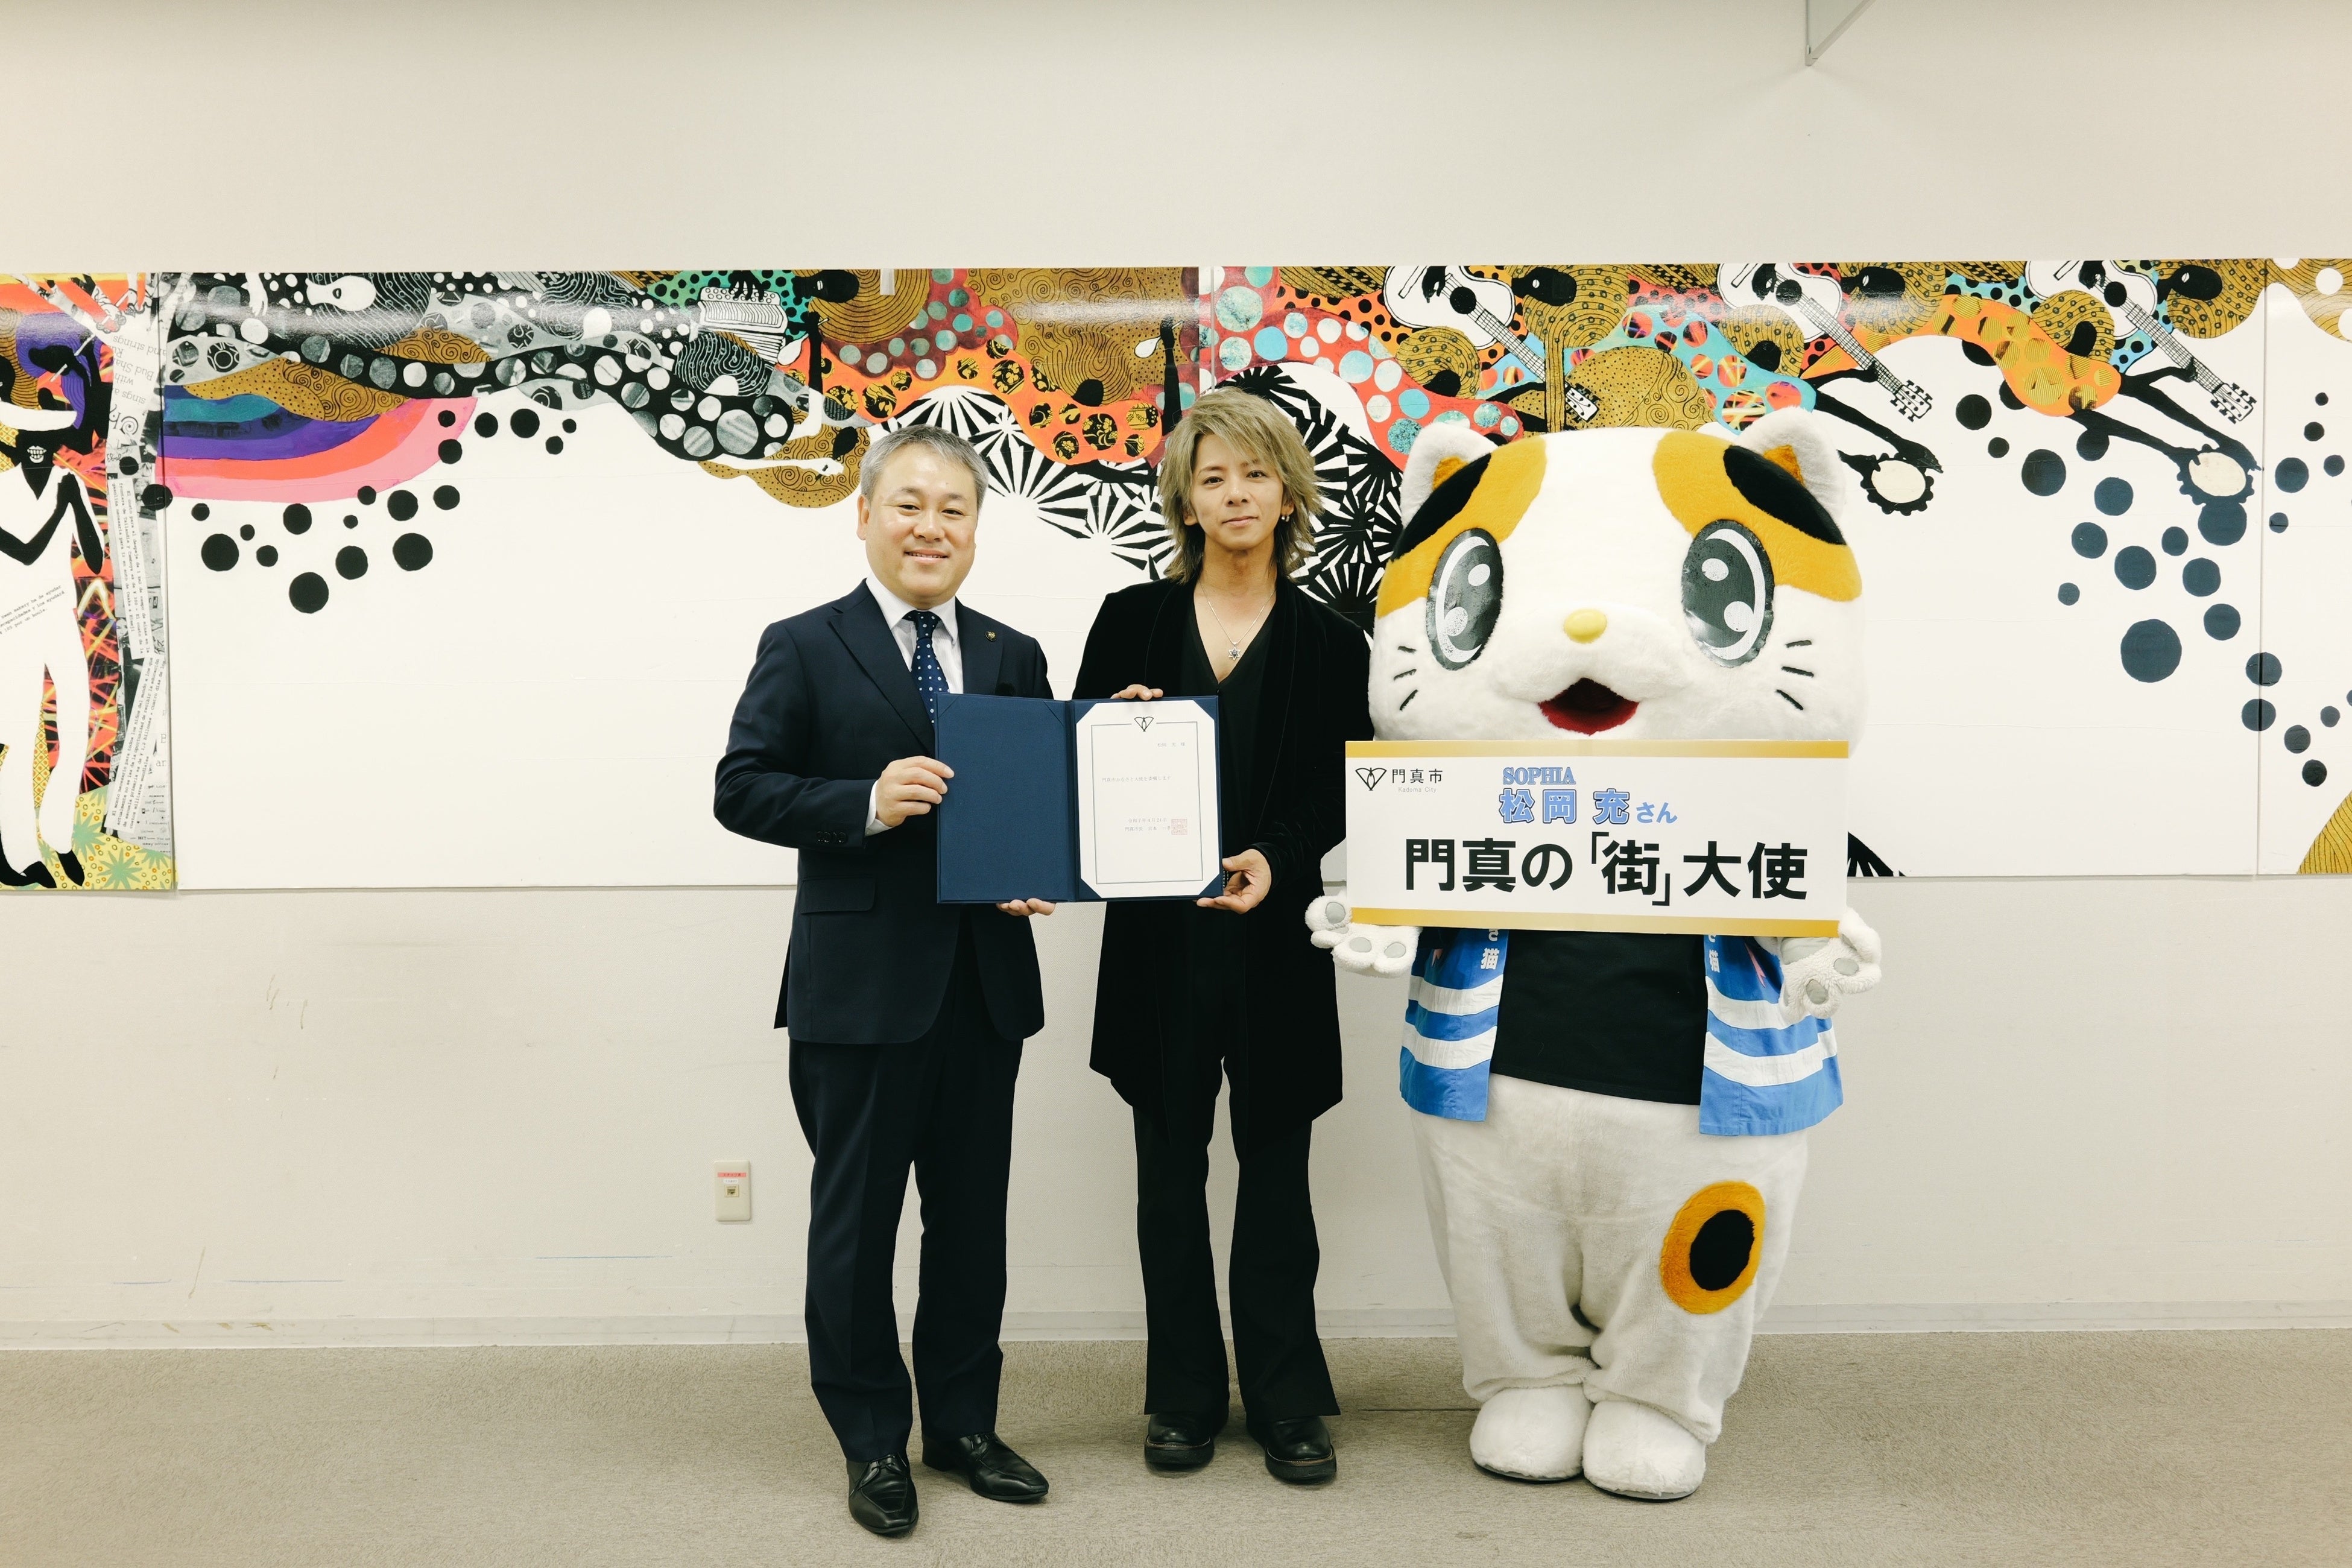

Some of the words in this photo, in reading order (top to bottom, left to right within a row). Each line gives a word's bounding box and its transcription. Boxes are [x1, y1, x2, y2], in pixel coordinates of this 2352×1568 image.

[113, 336, 145, 351] strings
[115, 373, 134, 385] with
[134, 365, 154, 381] Bud
[122, 391, 146, 405] sings
[134, 721, 144, 753] oportunidad
[118, 766, 127, 791] necesario
[1392, 768, 1443, 783] 門真市
[1503, 767, 1576, 785] SOPHIA
[130, 774, 139, 797] primaria
[1406, 832, 1808, 906] 門真の「街」大使
